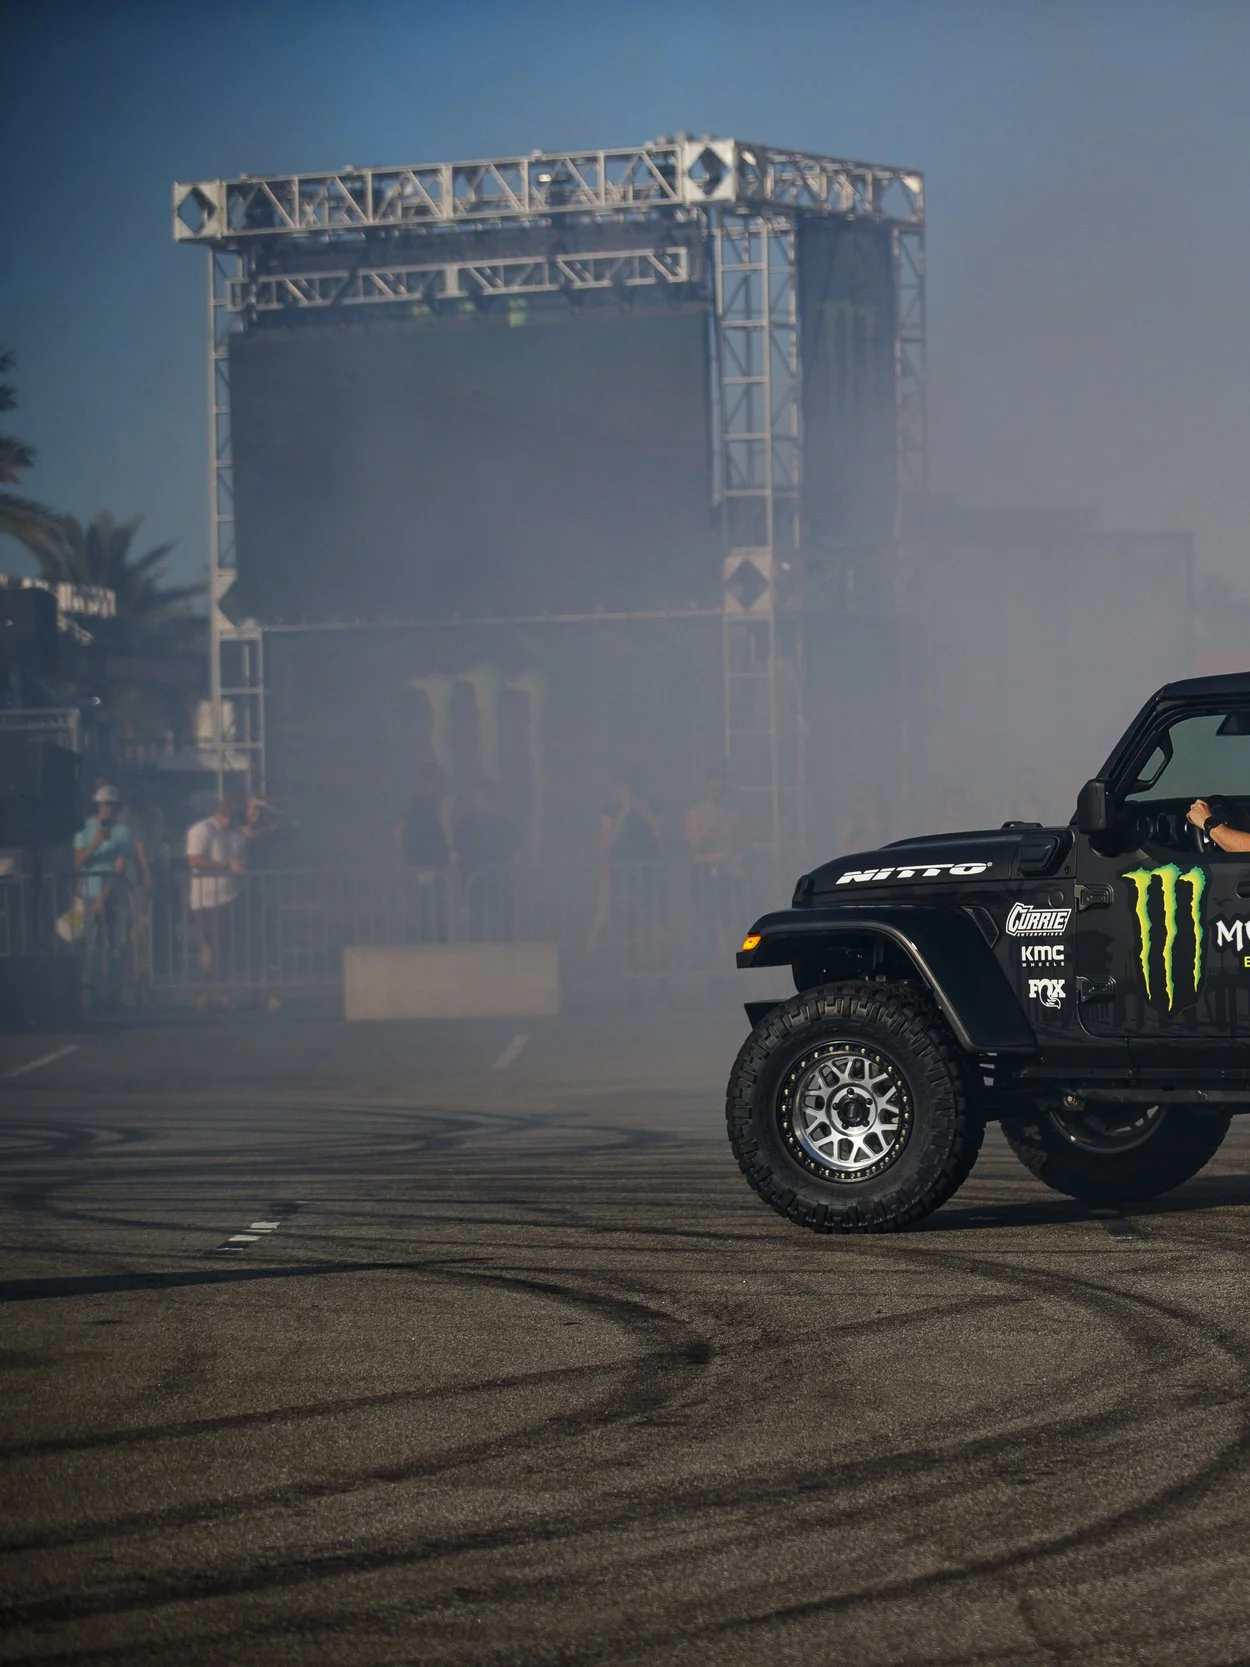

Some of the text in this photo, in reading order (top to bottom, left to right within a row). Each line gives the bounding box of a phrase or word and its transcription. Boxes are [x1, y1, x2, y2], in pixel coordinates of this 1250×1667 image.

[836, 863, 987, 885] NITTO
[1008, 905, 1068, 933] CURRIE
[1021, 945, 1065, 961] KMC
[1028, 978, 1067, 1009] FOX
